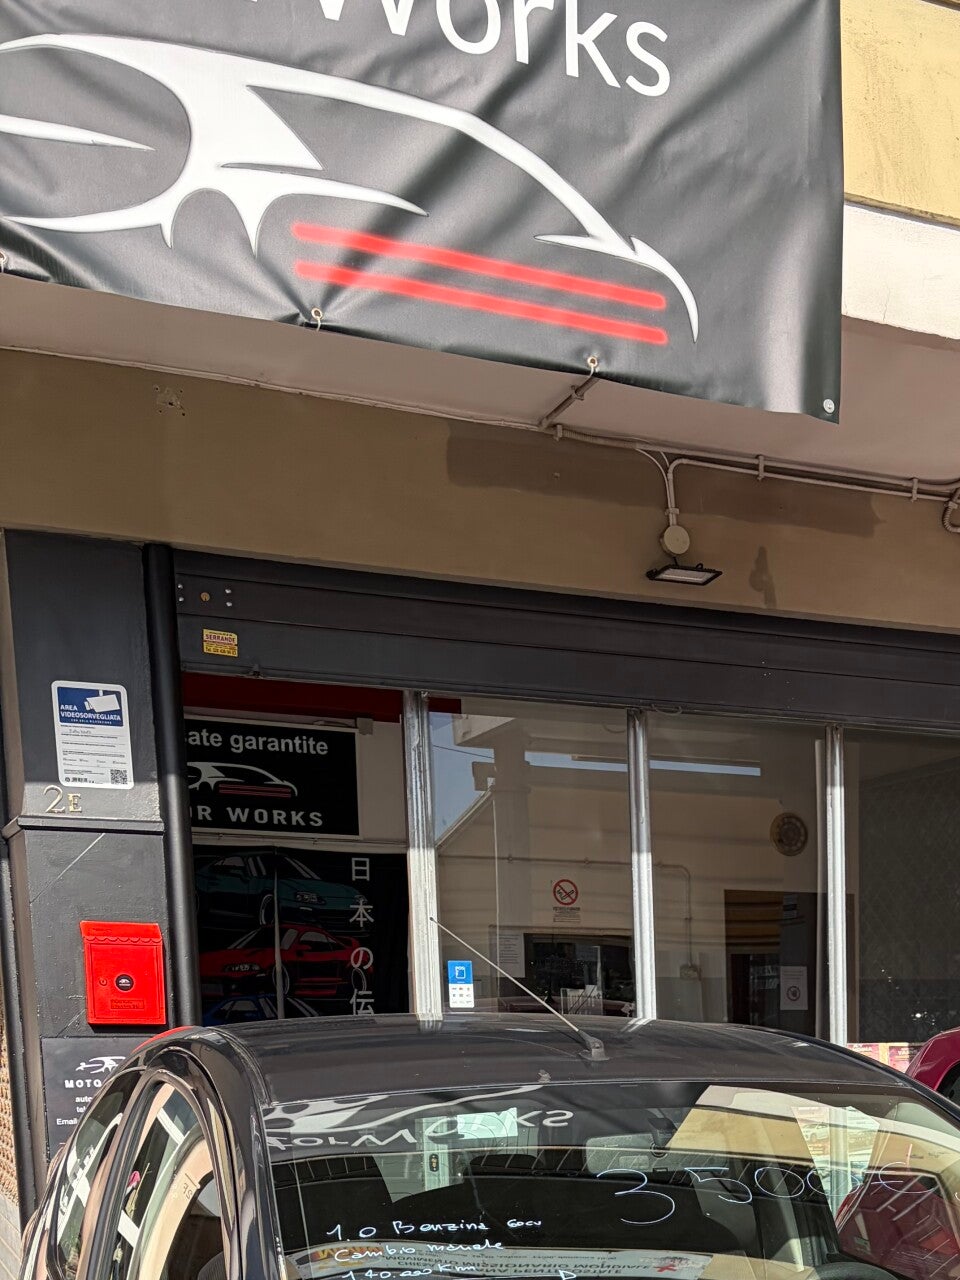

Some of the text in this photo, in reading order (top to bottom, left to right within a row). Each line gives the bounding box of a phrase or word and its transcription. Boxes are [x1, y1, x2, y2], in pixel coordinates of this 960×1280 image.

[60, 711, 121, 721] VIDEOSORVEGLIATA
[185, 728, 329, 756] ate garantite
[226, 807, 323, 827] WORKS
[392, 1220, 490, 1234] Benzina
